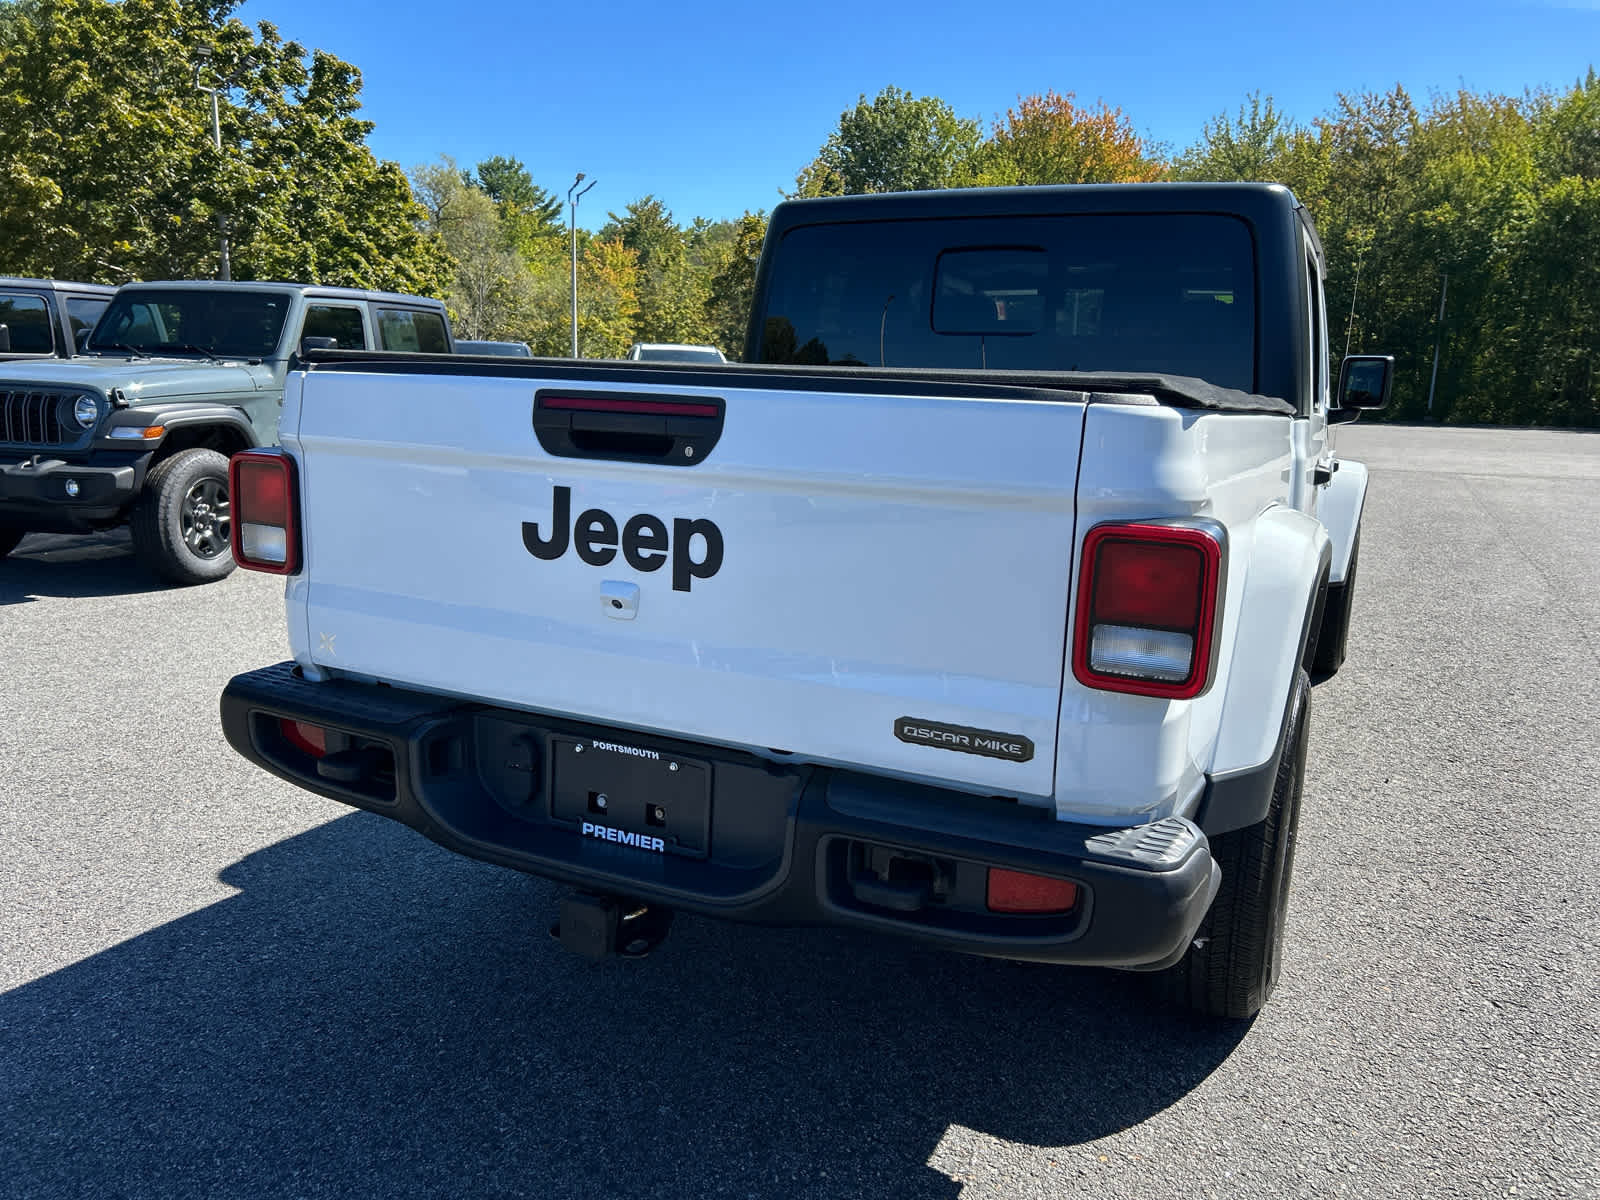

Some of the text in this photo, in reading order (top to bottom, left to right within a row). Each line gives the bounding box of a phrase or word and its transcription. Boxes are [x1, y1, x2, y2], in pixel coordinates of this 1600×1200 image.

[521, 485, 724, 592] Jeep
[592, 740, 660, 760] PORTSMOUTH
[903, 725, 1022, 755] OSCAR MIKE
[582, 822, 664, 852] PREMIER
